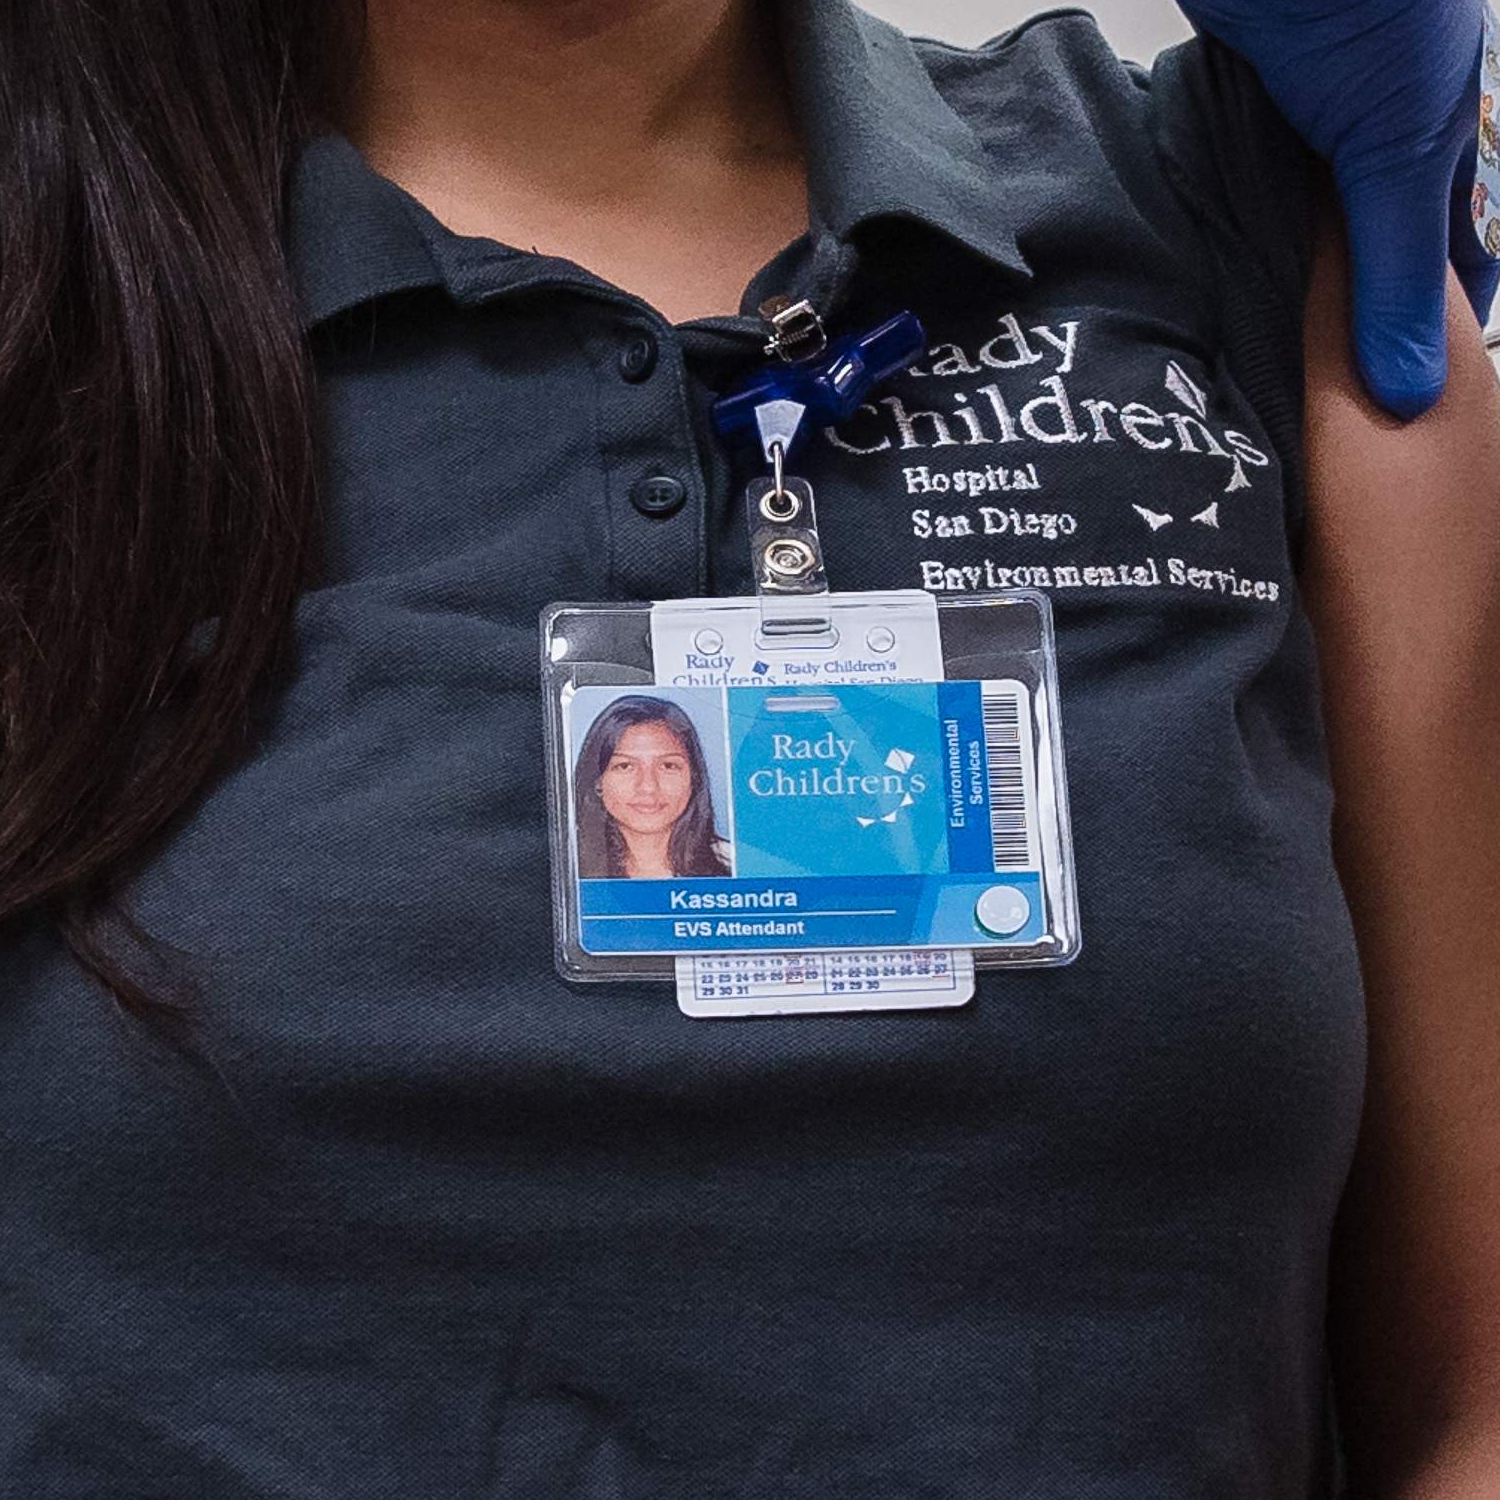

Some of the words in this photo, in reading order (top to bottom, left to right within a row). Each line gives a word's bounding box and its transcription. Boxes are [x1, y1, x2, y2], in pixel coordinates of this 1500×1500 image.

[908, 313, 1081, 376] ady
[902, 464, 1042, 497] Hospital
[911, 509, 973, 539] San
[983, 507, 1078, 540] Diego
[920, 558, 1159, 591] Environmental
[1168, 558, 1280, 601] Services
[686, 654, 735, 670] Rady
[784, 663, 821, 677] Rady
[824, 660, 897, 674] Children's
[771, 732, 856, 766] Rady
[944, 719, 965, 828] Environmental
[970, 740, 983, 805] Services
[670, 889, 797, 909] Kassandra
[674, 921, 712, 937] EVS
[716, 920, 805, 936] Attendant
